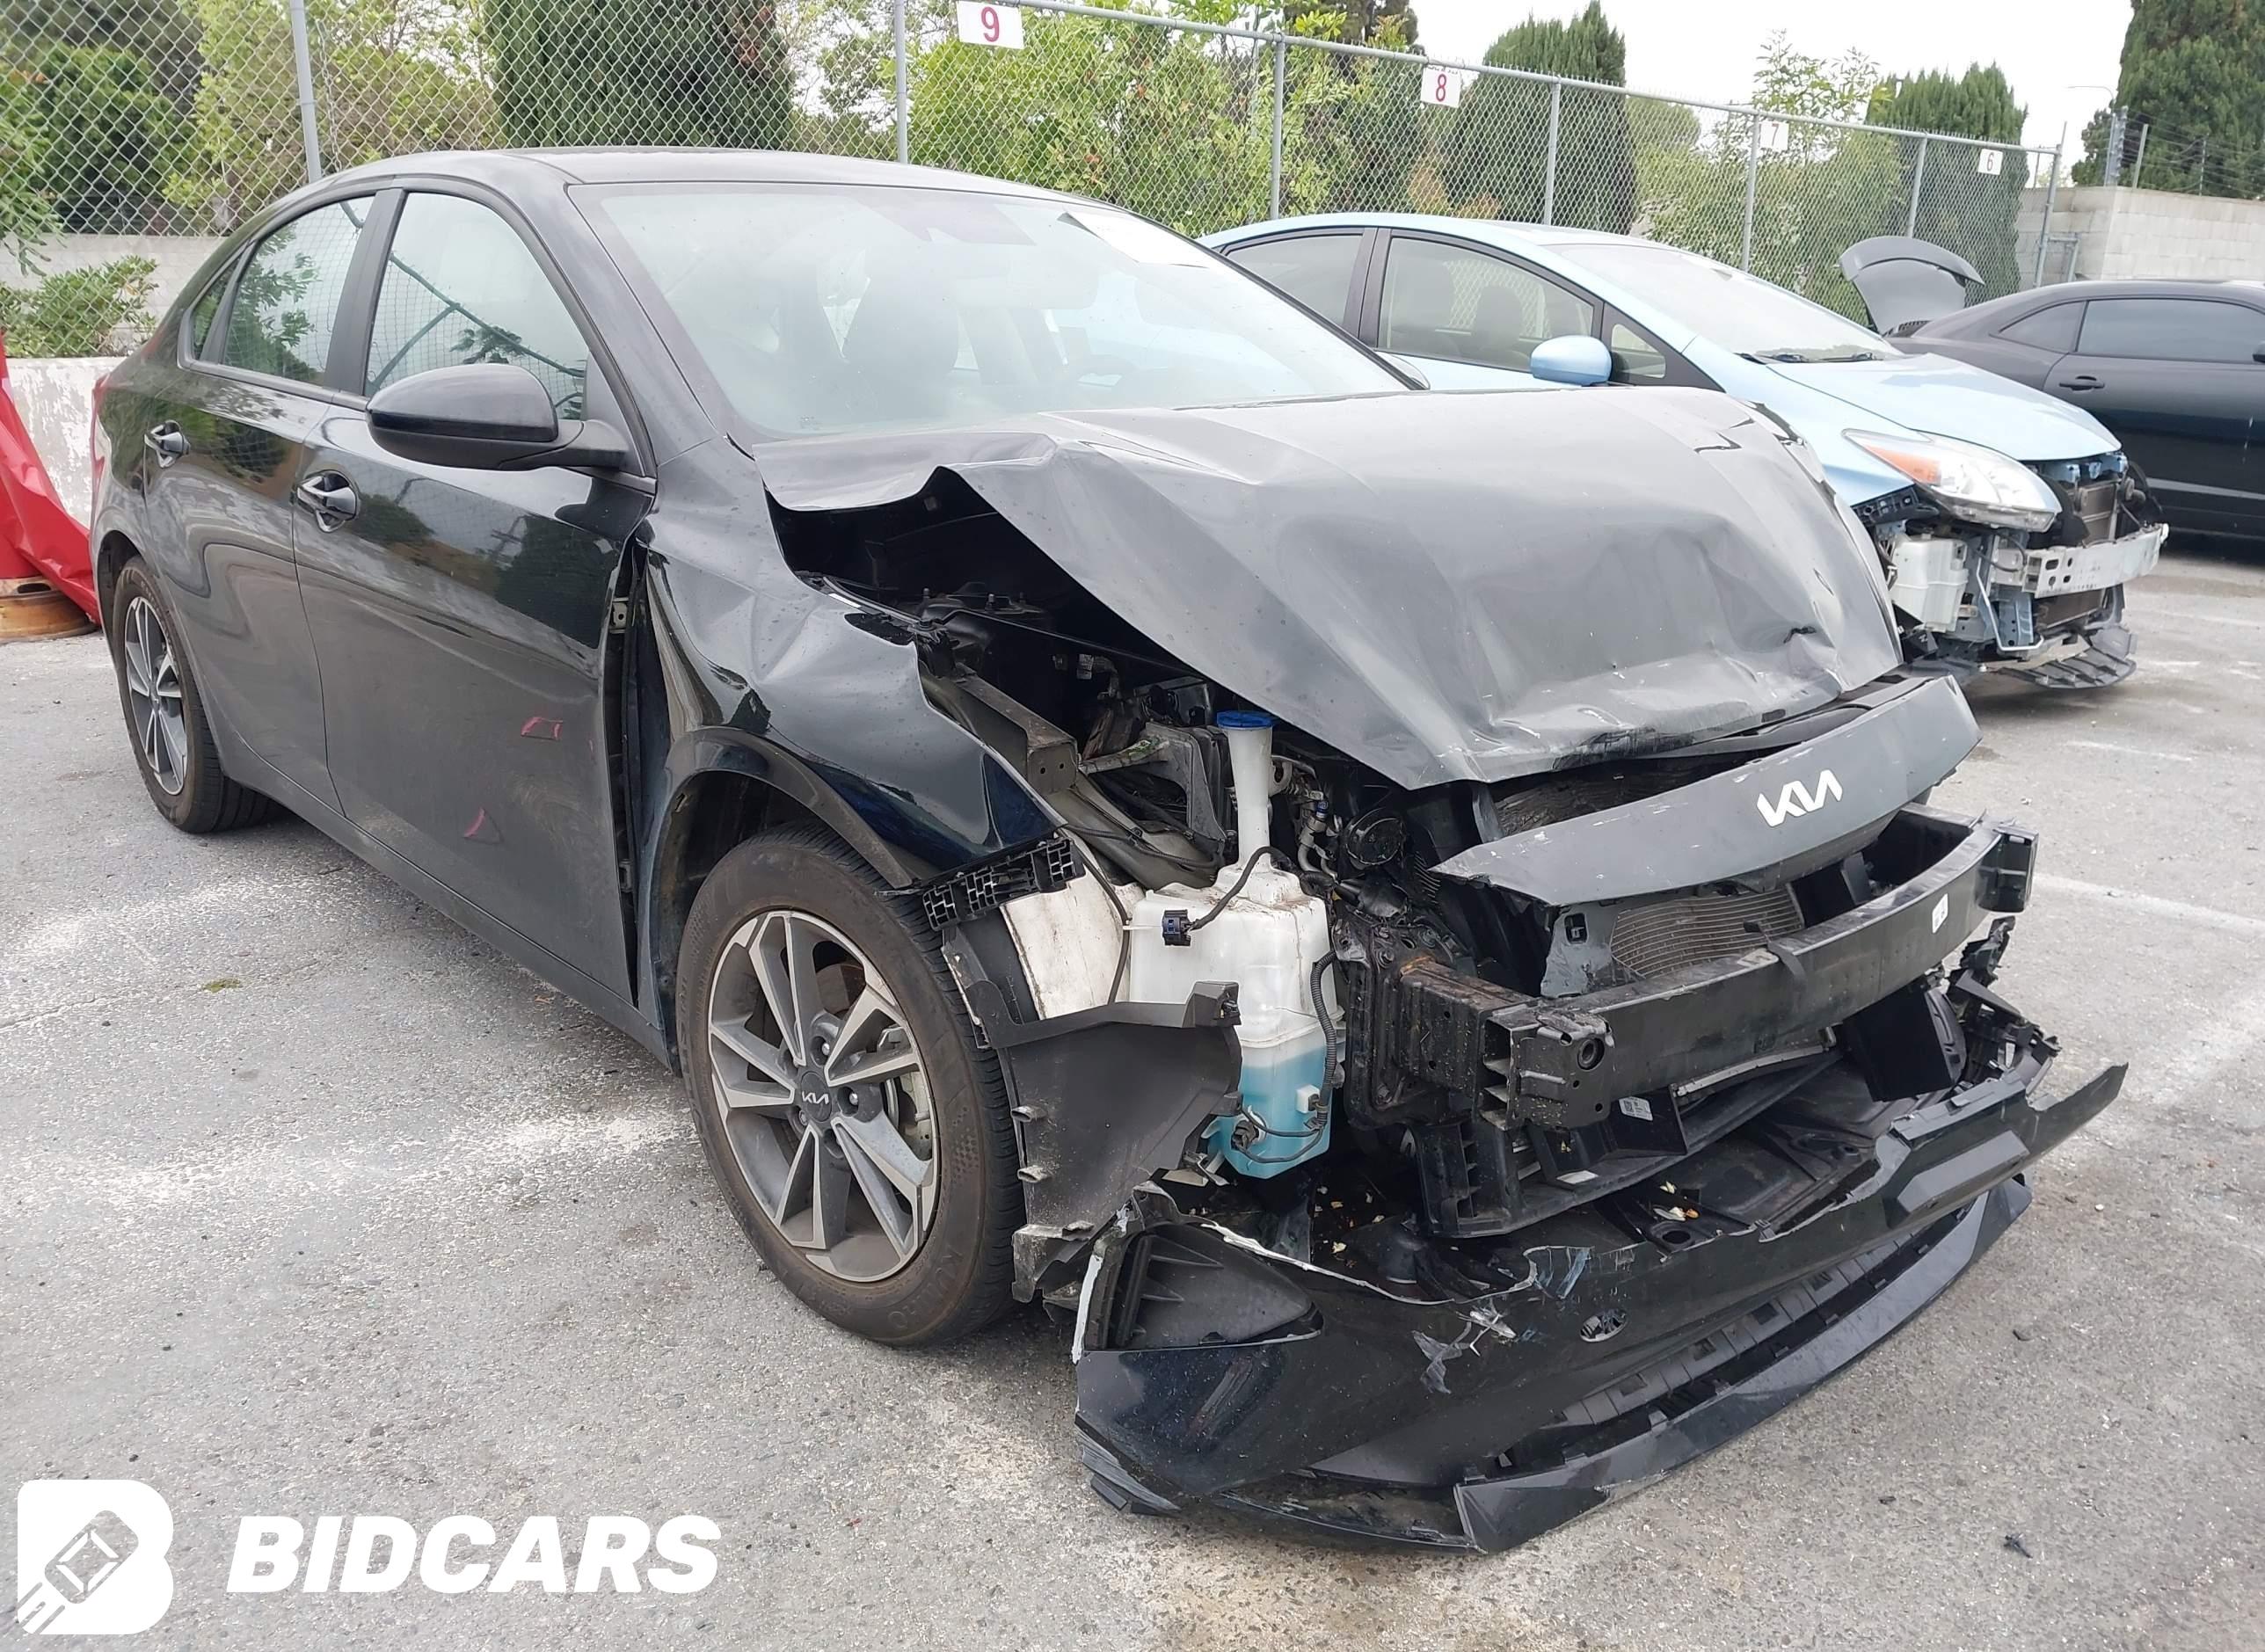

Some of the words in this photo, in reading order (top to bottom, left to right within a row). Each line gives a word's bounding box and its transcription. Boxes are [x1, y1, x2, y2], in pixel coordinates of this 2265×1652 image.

[980, 6, 1000, 42] 9
[1436, 73, 1447, 102] 8
[1771, 123, 1780, 147] 7
[1986, 151, 1994, 172] 6
[1757, 769, 1843, 827] KIA
[801, 1089, 829, 1105] KIA
